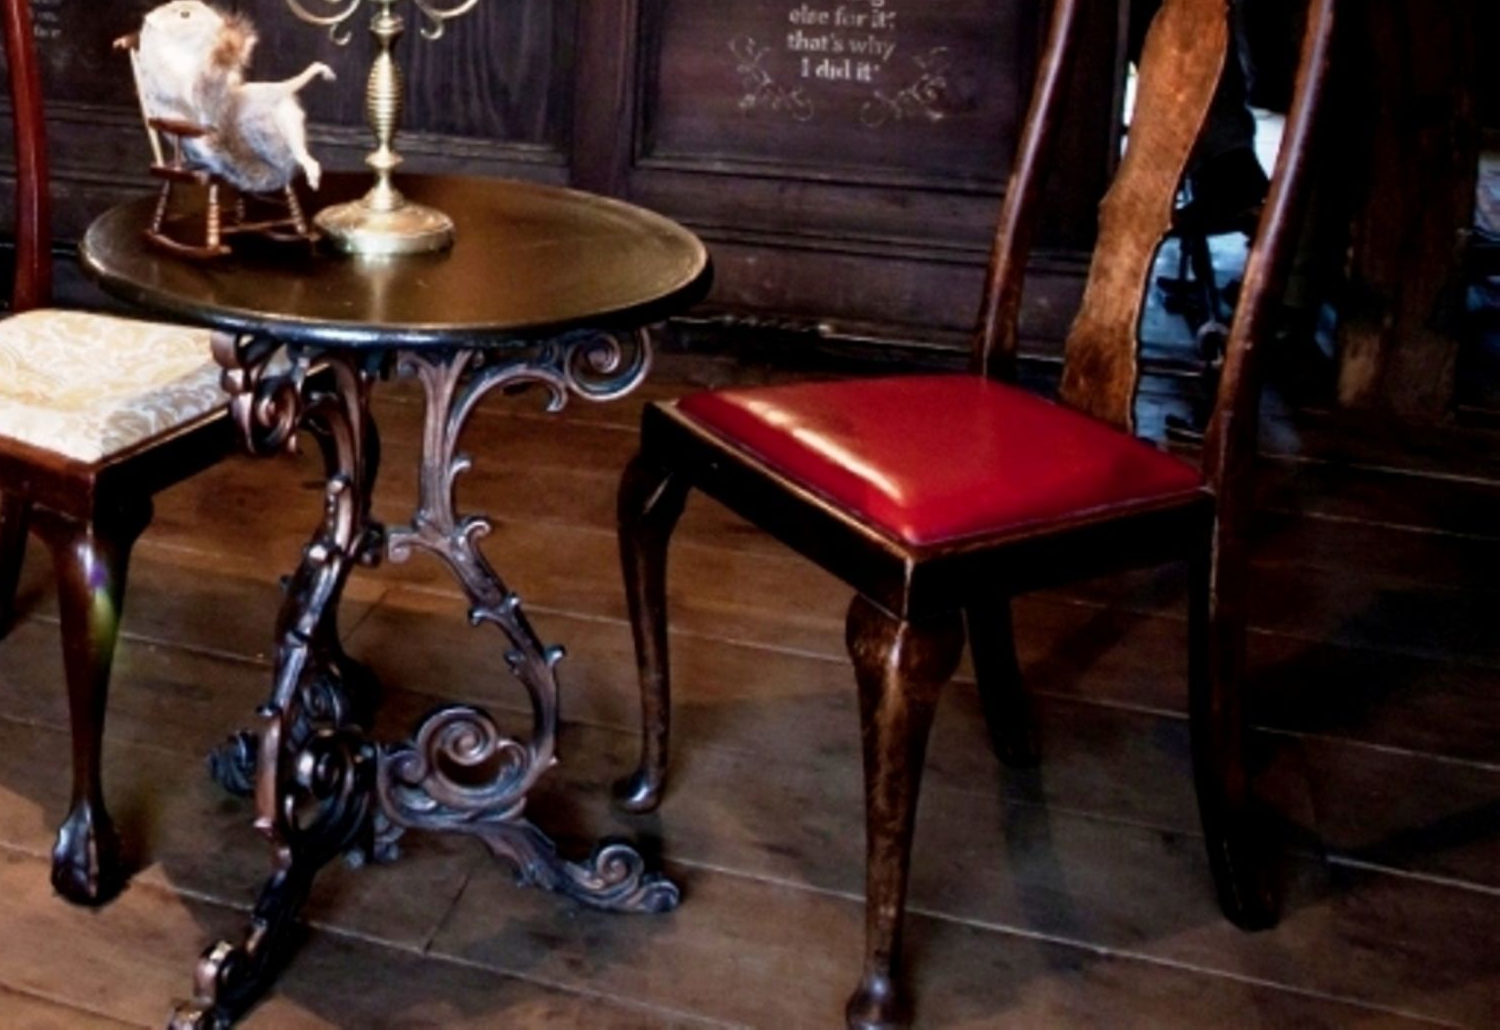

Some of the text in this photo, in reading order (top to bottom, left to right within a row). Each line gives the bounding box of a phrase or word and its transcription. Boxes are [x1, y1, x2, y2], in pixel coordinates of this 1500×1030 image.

[789, 4, 830, 25] else
[834, 5, 867, 27] for
[786, 30, 896, 61] that's why
[801, 57, 810, 78] I
[815, 58, 850, 80] did
